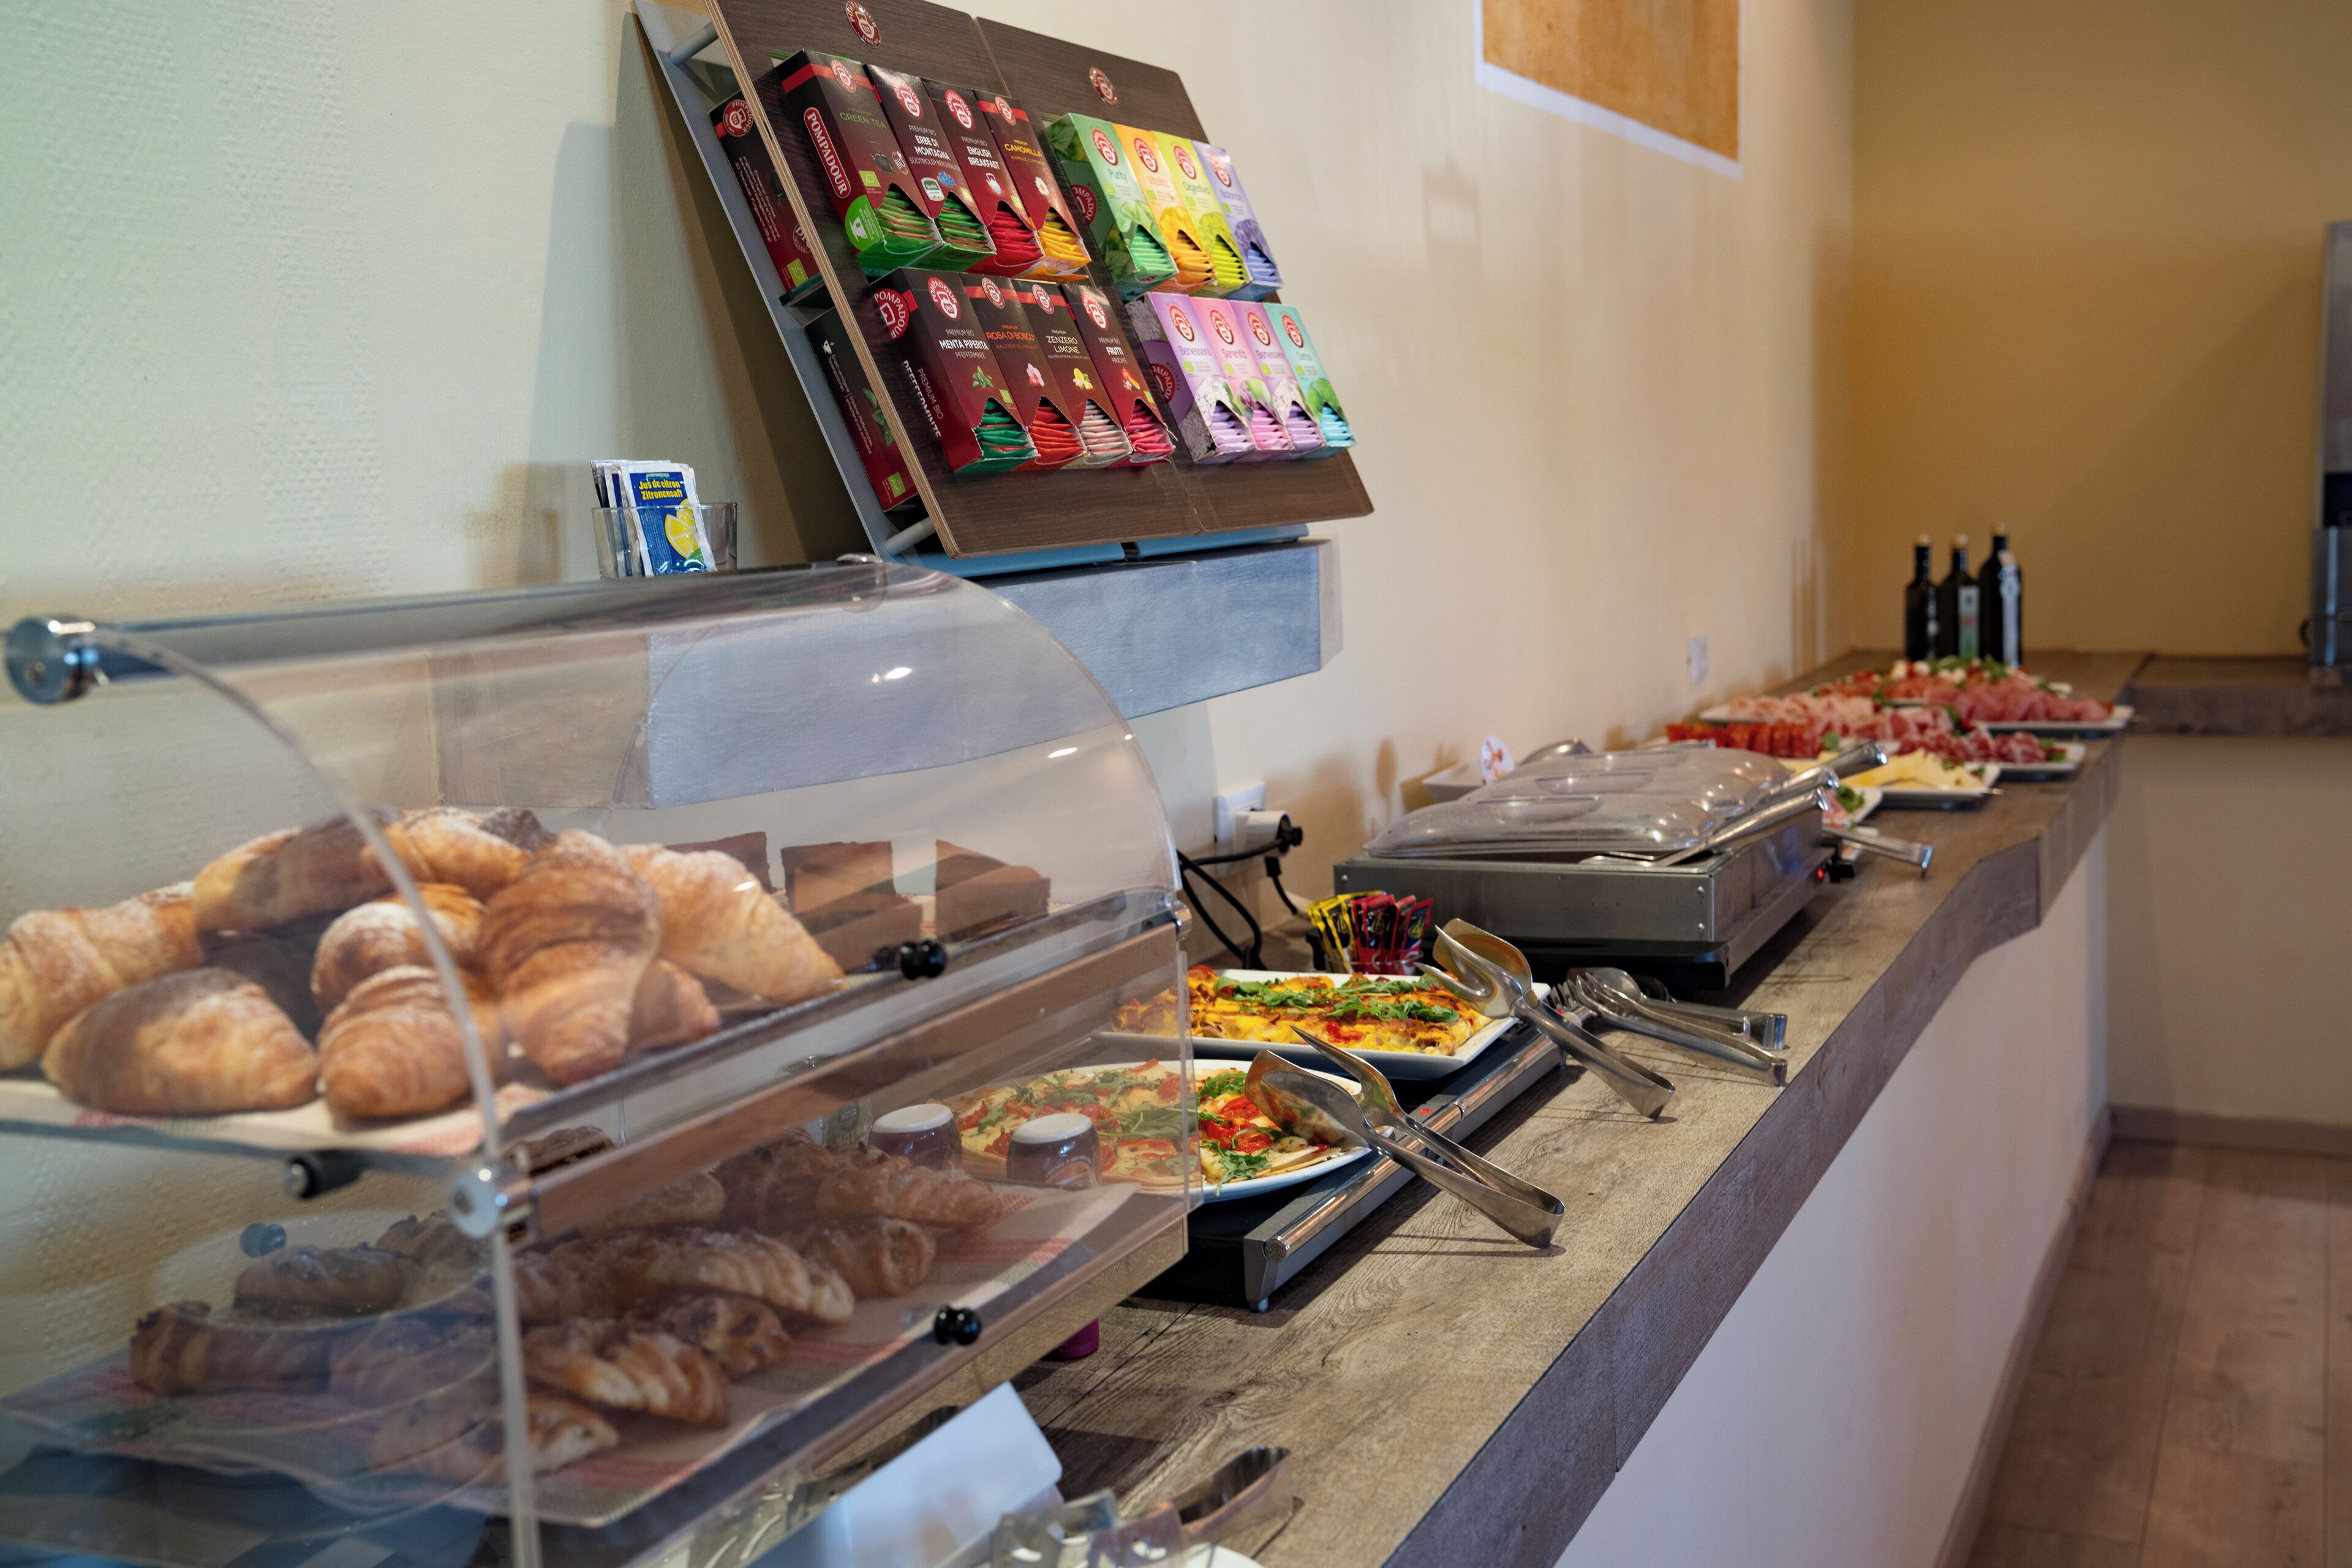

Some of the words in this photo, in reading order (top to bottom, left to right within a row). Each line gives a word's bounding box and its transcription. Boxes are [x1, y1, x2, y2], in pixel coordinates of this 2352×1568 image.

[946, 92, 971, 116] POMPADOUR
[732, 102, 752, 133] POMPADOUR
[840, 112, 870, 125] GREEN
[871, 119, 887, 129] TEA
[908, 124, 928, 134] PREMIUM
[915, 135, 932, 146] ERBE
[961, 136, 980, 145] PREMIUM
[807, 112, 847, 195] POMPADOUR
[914, 146, 951, 160] MONTAGNA
[967, 146, 992, 158] ENGLISH
[1005, 143, 1042, 157] CAMOMILLA
[894, 158, 905, 170] BIO
[968, 157, 1000, 170] BREAKFAST
[1107, 168, 1127, 183] Purity
[1072, 187, 1094, 221] OMPADO
[930, 280, 957, 303] POMPADOUR
[874, 291, 906, 339] POMPADOUR
[986, 331, 1008, 340] ROSA
[1046, 336, 1078, 344] ZENZERO
[939, 339, 965, 349] MENTA
[964, 340, 989, 350] PIPERITA
[1178, 345, 1212, 356] Benessere
[1106, 347, 1124, 355] FRUTTI
[918, 368, 937, 404] PREMIUM
[933, 404, 943, 420] BIO
[639, 481, 652, 489] Jus
[652, 479, 661, 488] de
[661, 479, 680, 488] citron
[641, 489, 683, 500] Zitronensaft
